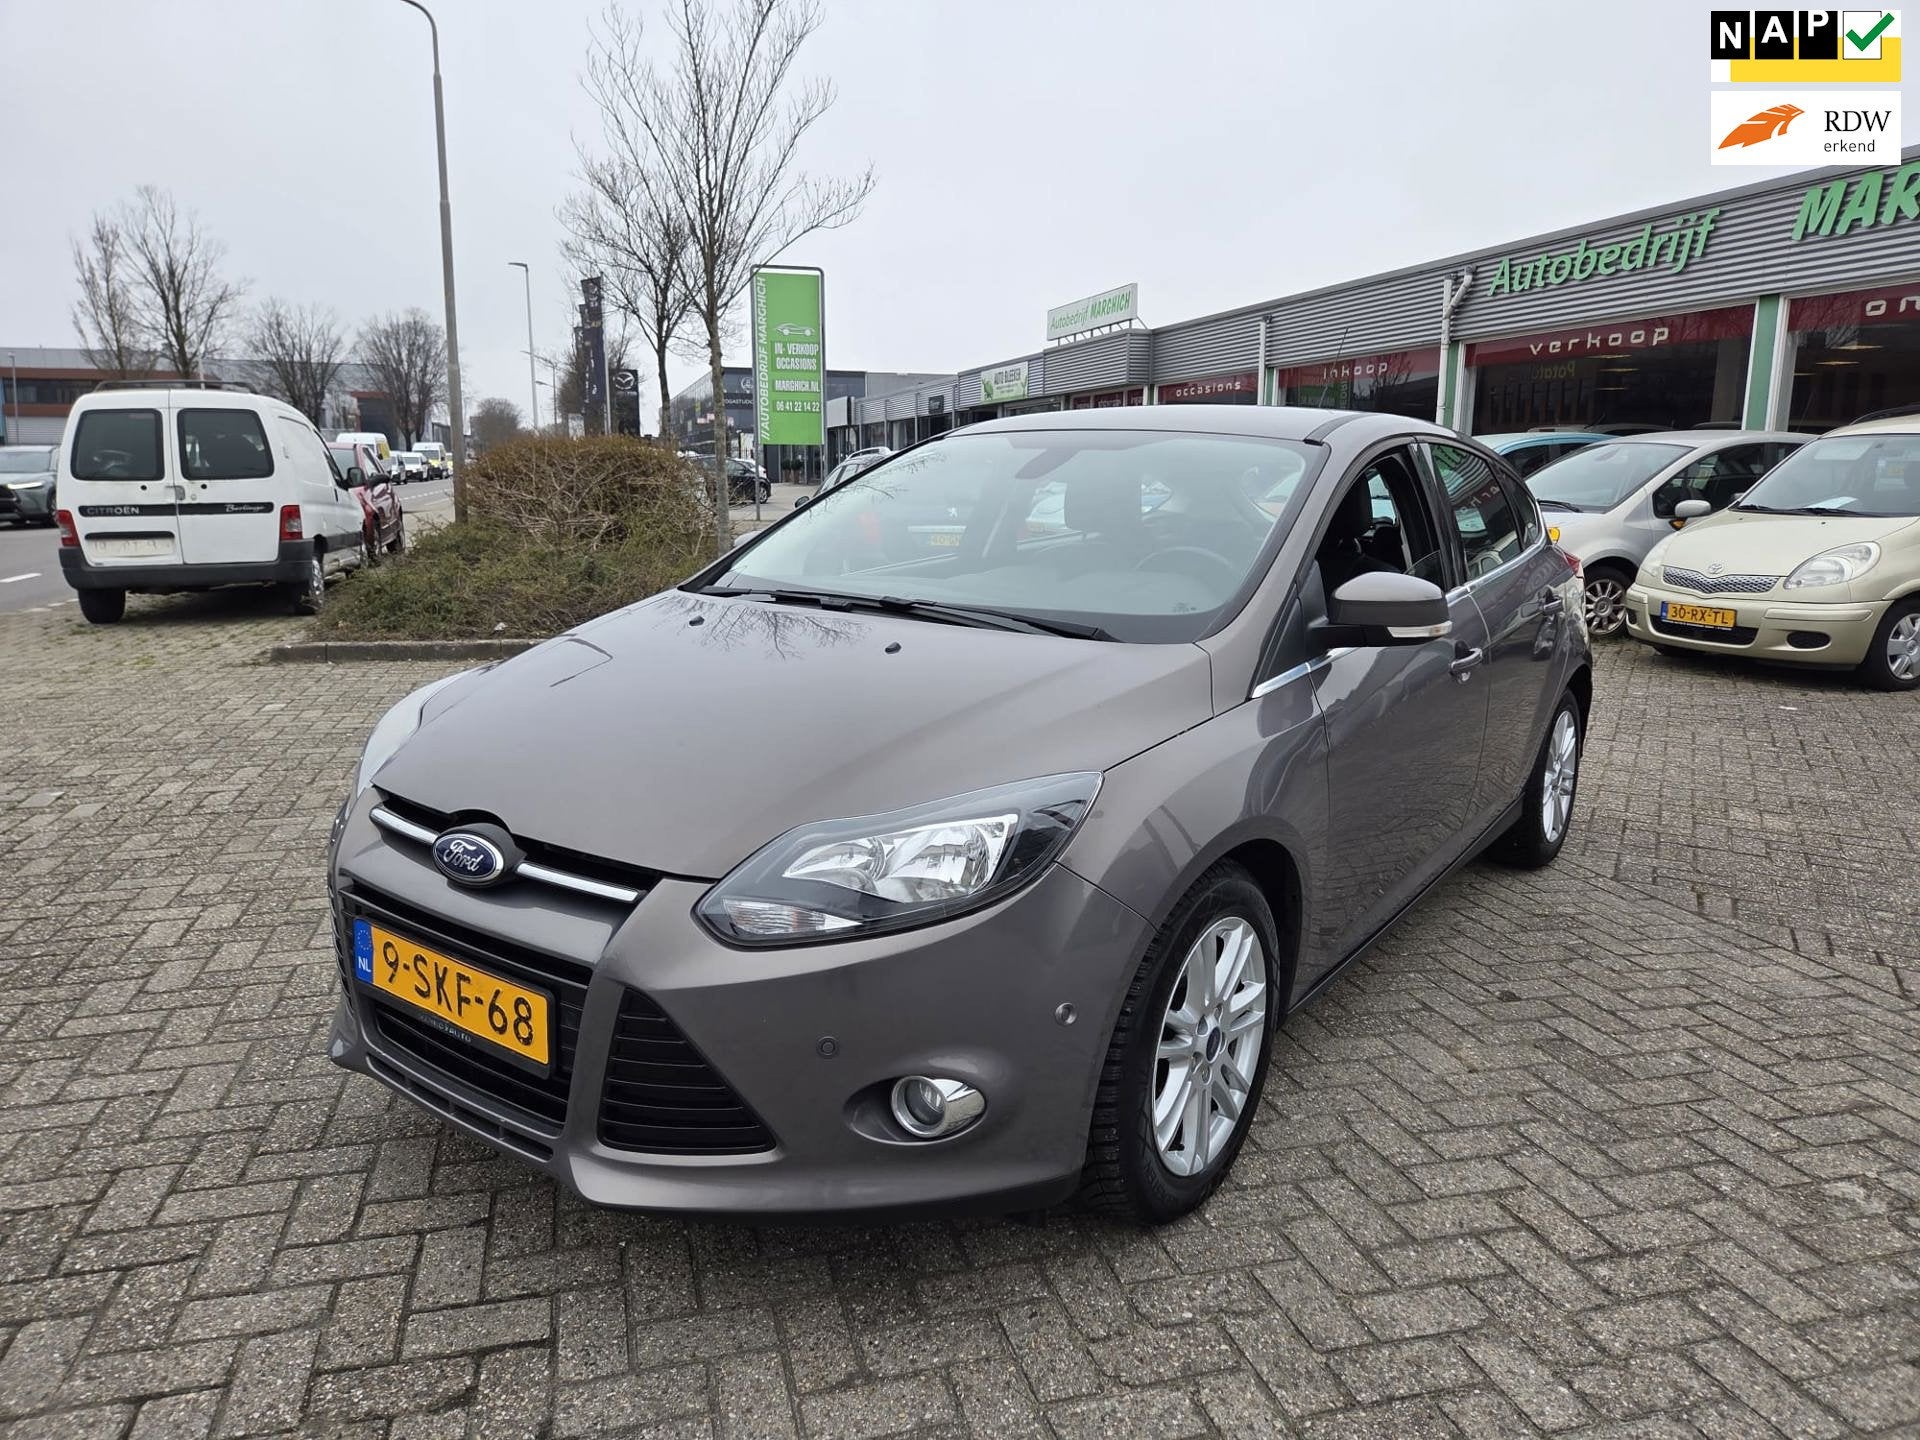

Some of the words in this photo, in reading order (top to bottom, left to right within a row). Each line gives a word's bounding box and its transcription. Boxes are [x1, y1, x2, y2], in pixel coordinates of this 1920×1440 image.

[1487, 208, 1721, 297] Autobedrijf
[757, 276, 768, 345] MARGHICH
[1050, 304, 1090, 331] Autobedrijf
[1090, 290, 1131, 319] MARGHICH
[787, 343, 819, 356] VERKOOP
[1530, 327, 1669, 356] verkoop
[776, 357, 817, 370] OCCASIONS
[1323, 362, 1388, 380] inkoop
[775, 379, 820, 392] MARGHICH.NL
[1176, 381, 1241, 398] occasions
[776, 400, 785, 412] 06
[785, 401, 793, 412] 41
[794, 401, 802, 412] 22
[803, 401, 811, 412] 14
[812, 402, 820, 412] 22
[1671, 606, 1729, 625] 30-RX-TL
[443, 839, 484, 872] Ford
[358, 957, 372, 973] NL
[382, 941, 535, 1046] 9-SKF-68
